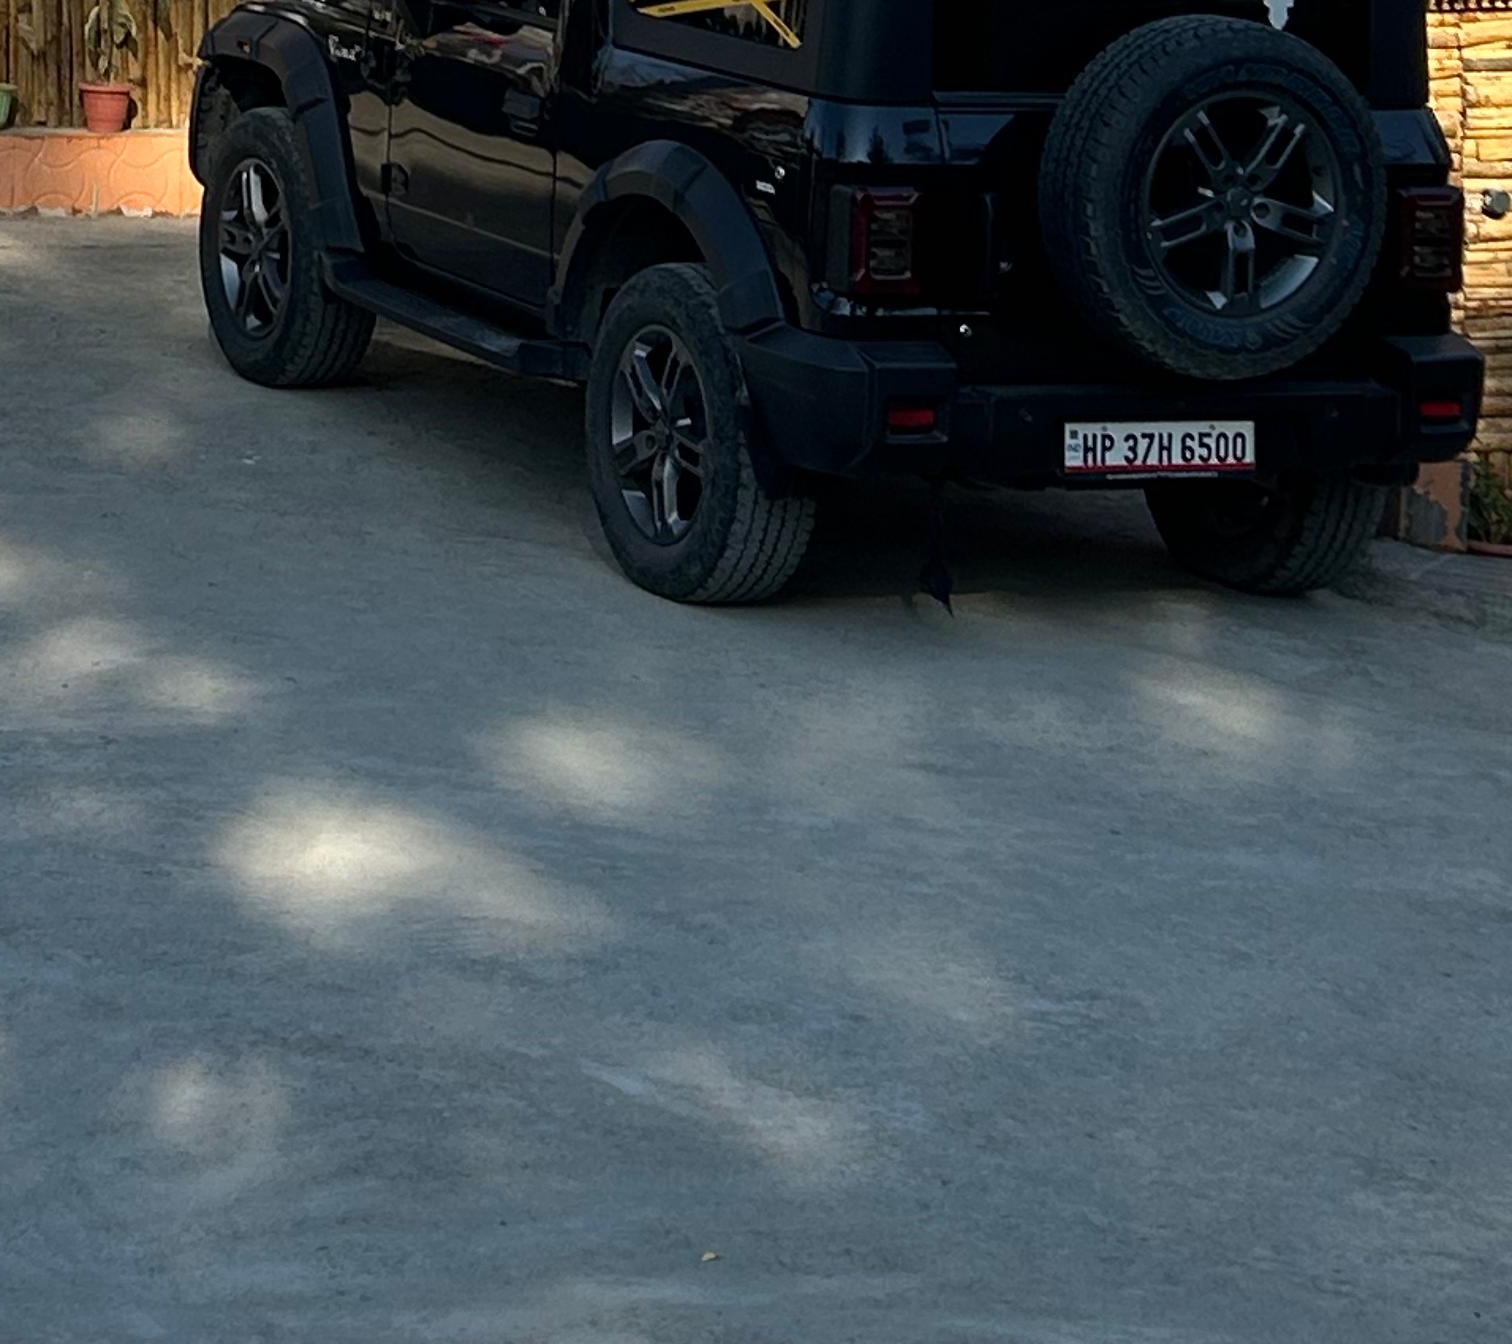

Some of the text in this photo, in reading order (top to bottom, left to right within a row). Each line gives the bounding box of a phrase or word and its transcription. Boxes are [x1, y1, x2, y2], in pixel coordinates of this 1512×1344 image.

[1083, 432, 1246, 467] HP 37H 6500
